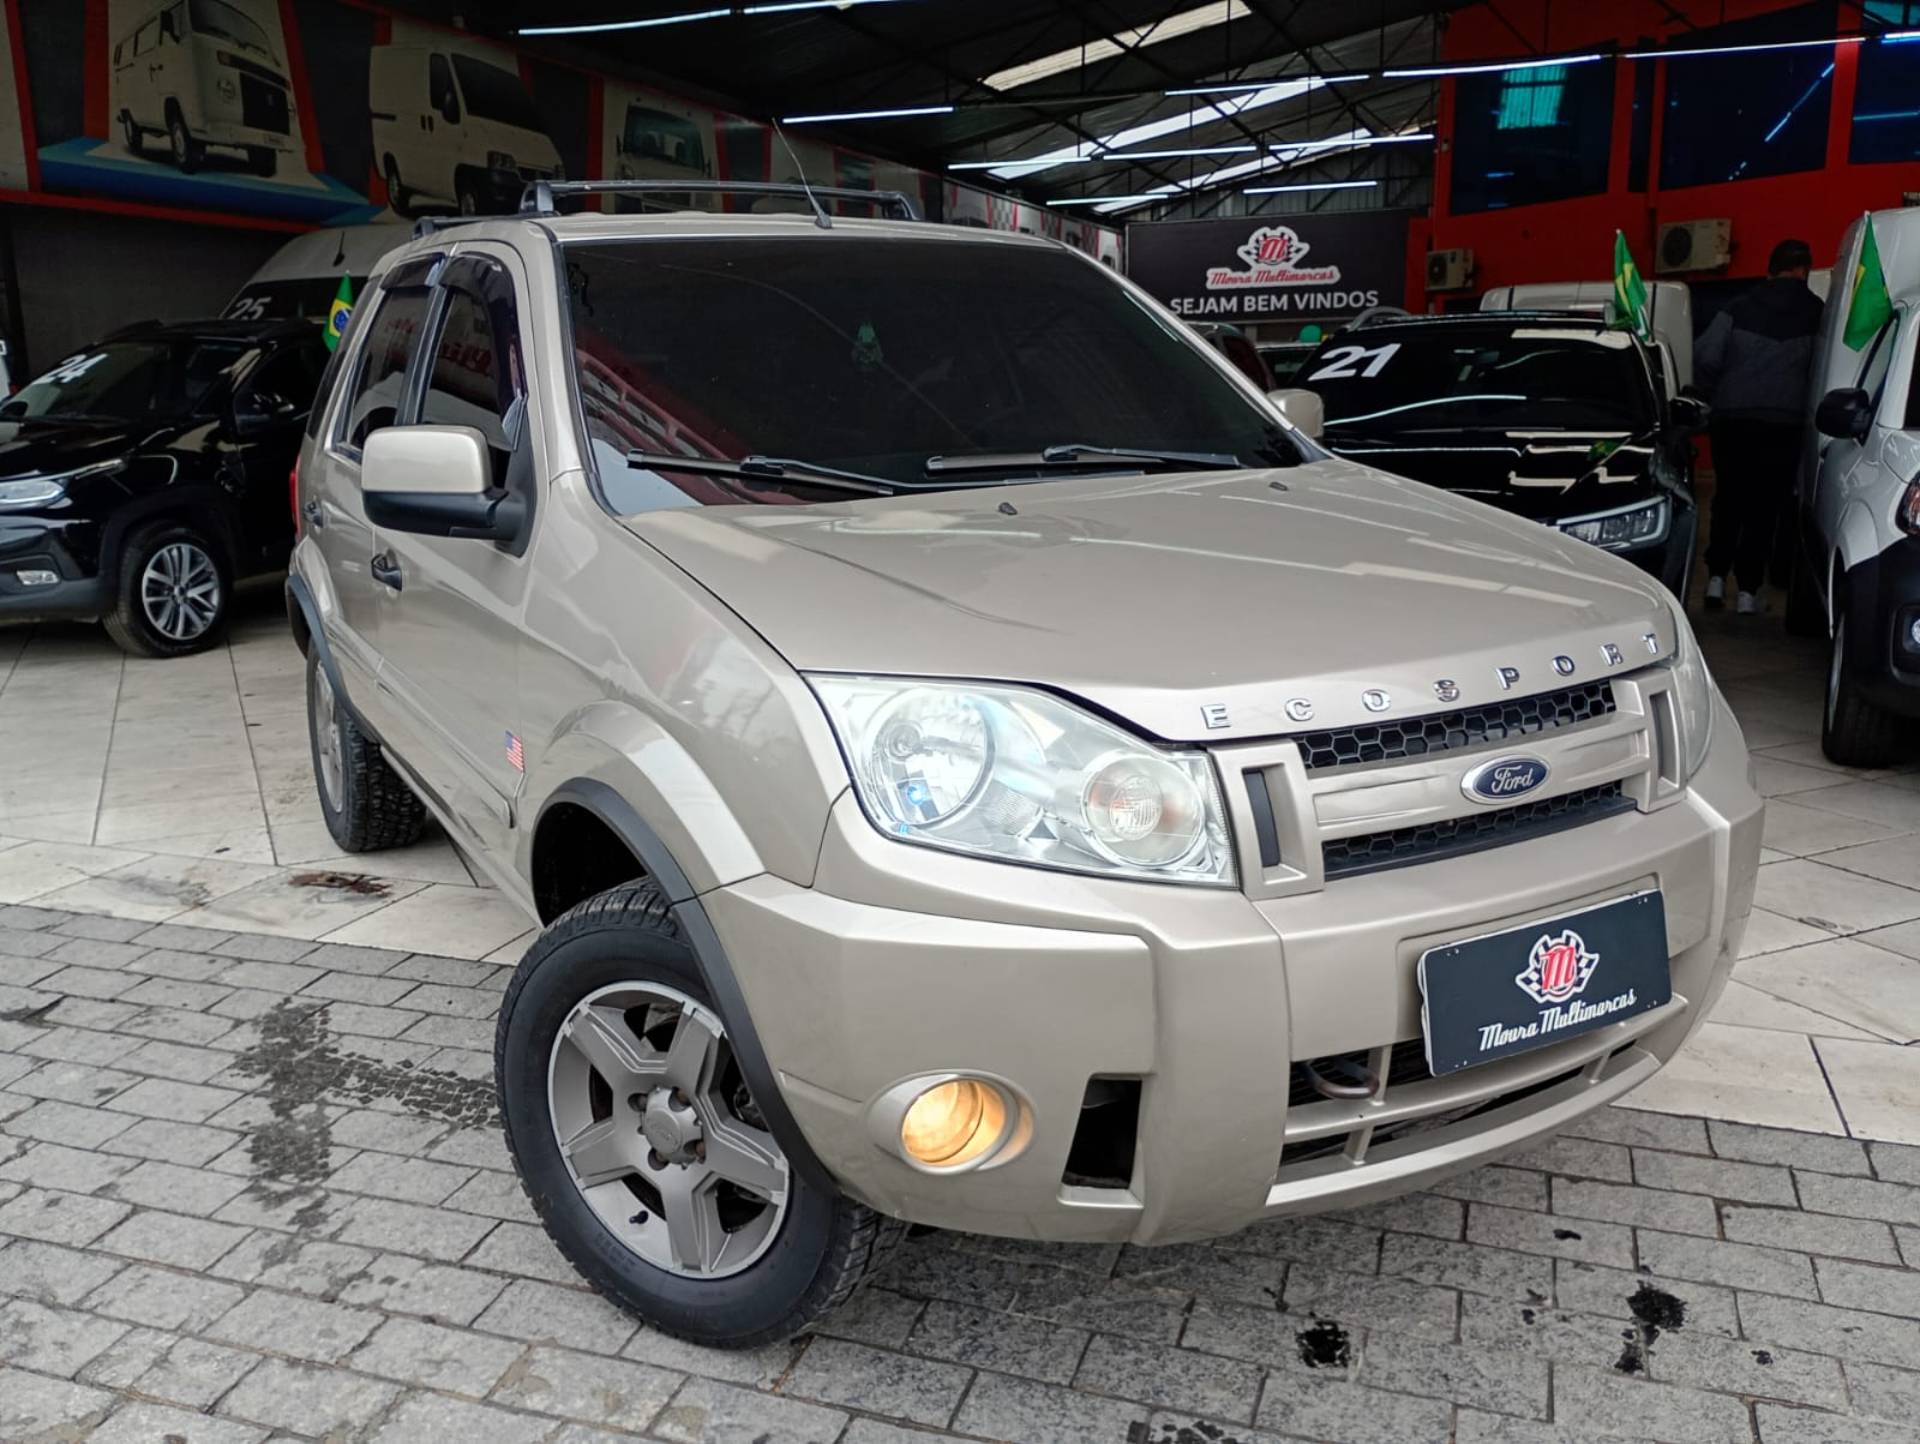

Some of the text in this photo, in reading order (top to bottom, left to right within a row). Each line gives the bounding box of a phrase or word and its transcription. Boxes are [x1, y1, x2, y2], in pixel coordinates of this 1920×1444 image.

[1210, 268, 1335, 285] Moura Multimarcas
[229, 297, 271, 320] 25
[1170, 290, 1379, 315] SEJAM BEM VINDOS
[1308, 343, 1402, 381] 21
[1201, 633, 1659, 730] ECOSPORT
[1491, 762, 1535, 794] Ford
[1478, 988, 1638, 1051] Moura Multimarcas
